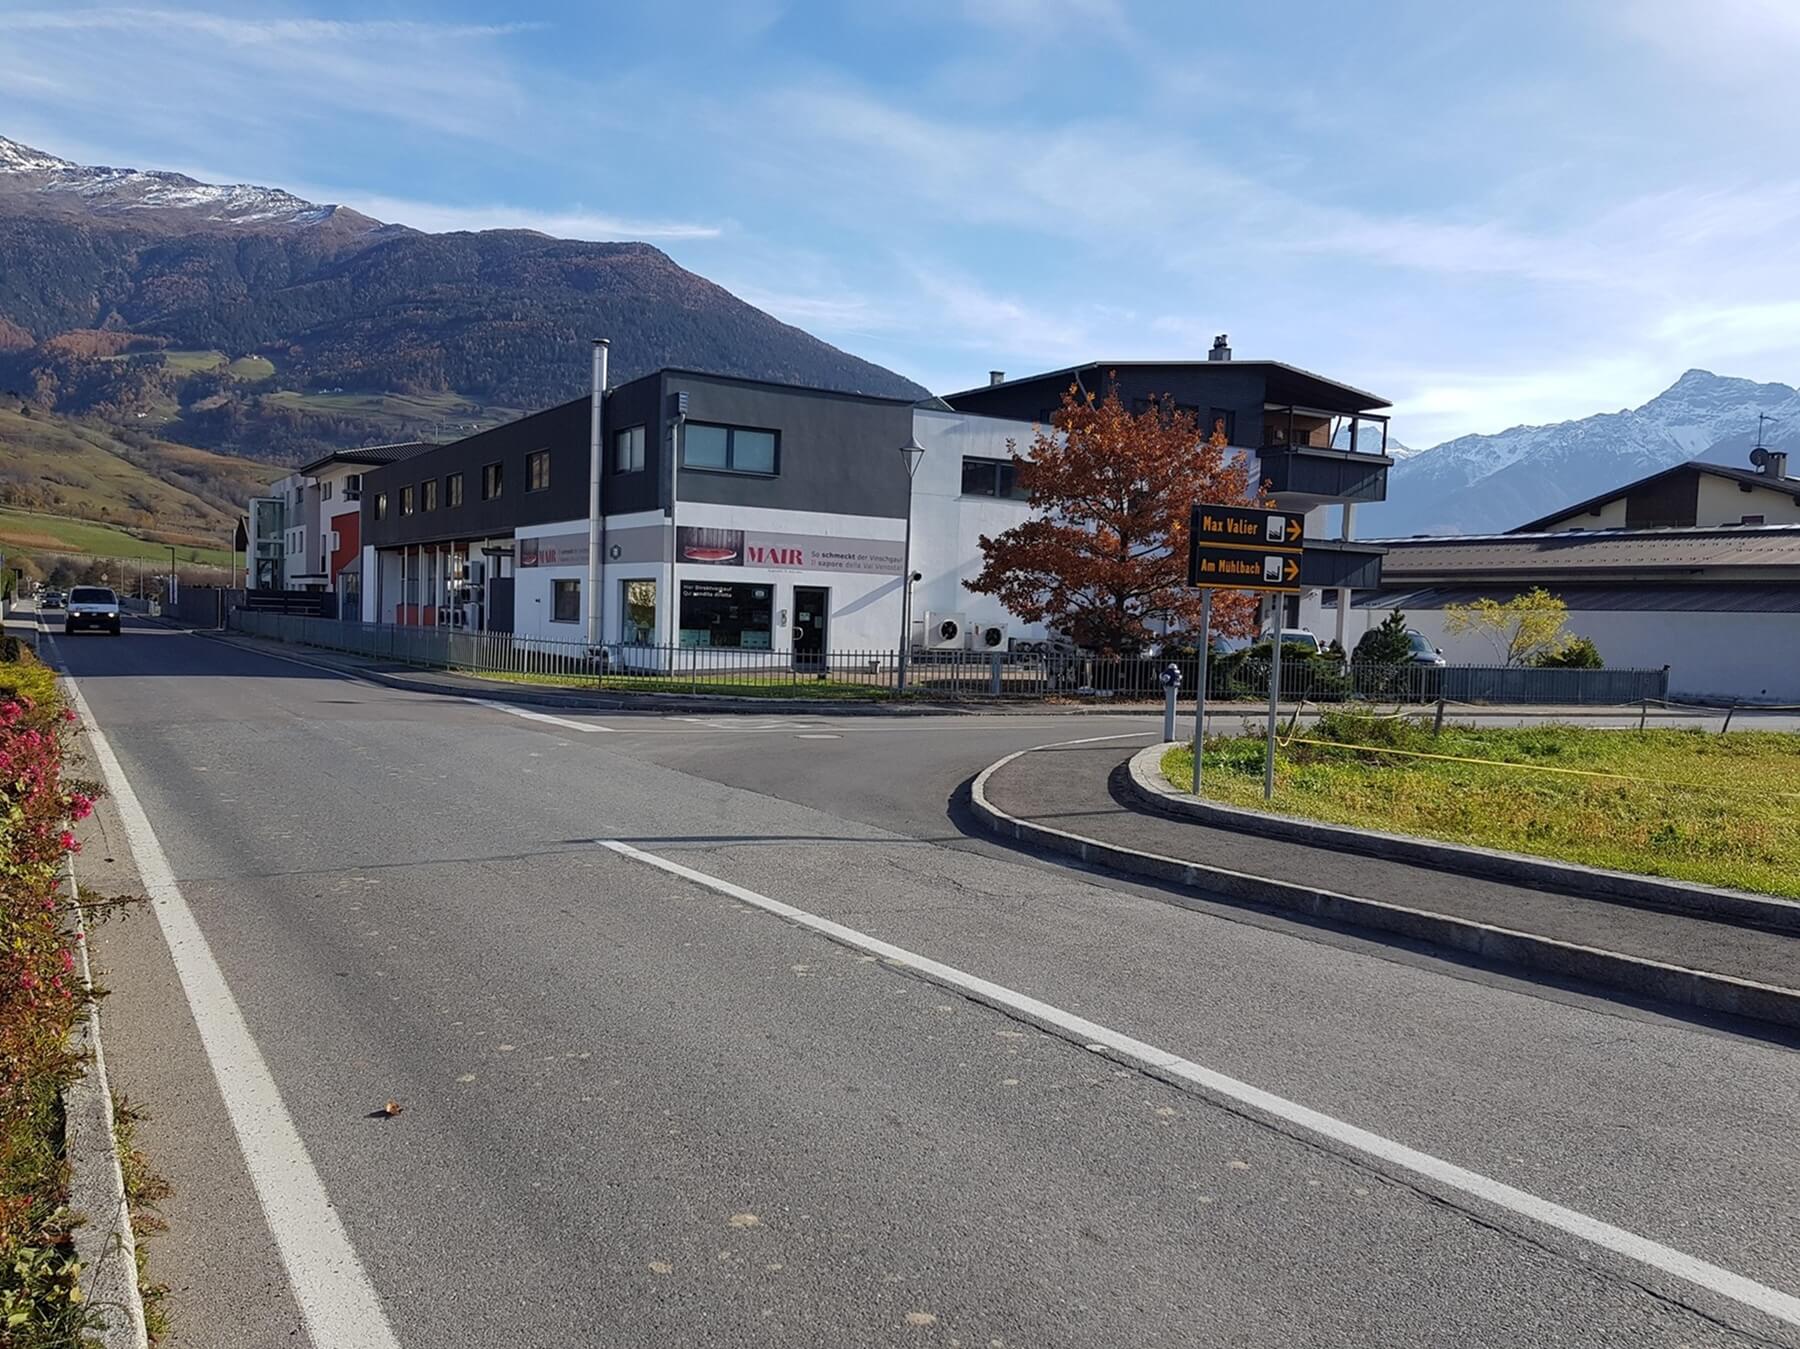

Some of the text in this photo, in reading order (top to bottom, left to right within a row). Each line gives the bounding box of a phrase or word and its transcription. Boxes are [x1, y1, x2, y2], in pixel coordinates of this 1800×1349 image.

[1203, 516, 1258, 535] Max Valier
[538, 549, 557, 564] MAIR
[747, 547, 803, 565] MAIR
[811, 551, 820, 559] So
[822, 551, 855, 561] schmeckt
[857, 553, 868, 561] der
[818, 560, 843, 568] sapore
[1201, 558, 1261, 575] Am Mühlbach
